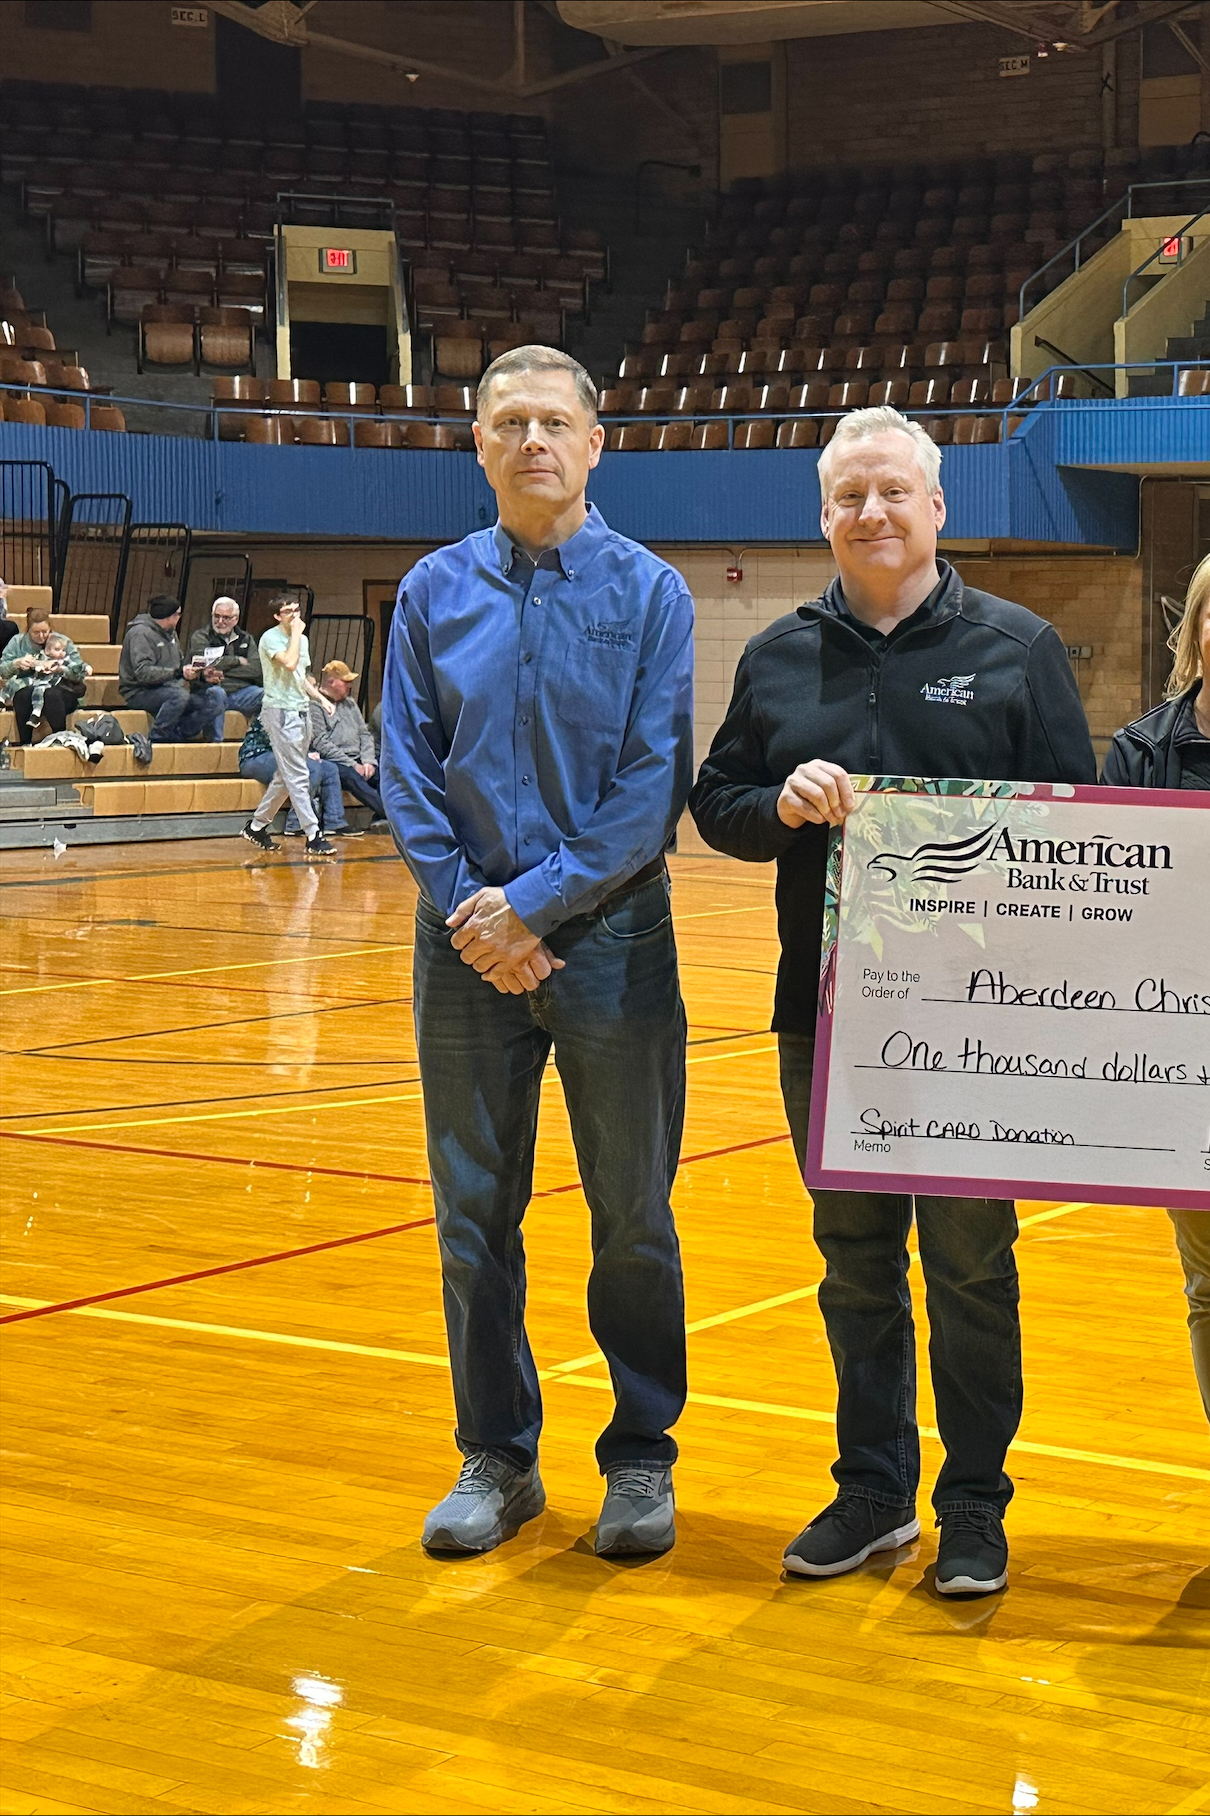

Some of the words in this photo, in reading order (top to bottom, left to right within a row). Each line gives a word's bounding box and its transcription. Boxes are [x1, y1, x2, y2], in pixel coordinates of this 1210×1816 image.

[1006, 868, 1066, 891] Bank
[1068, 873, 1089, 892] &
[1089, 871, 1150, 895] Trust
[909, 898, 976, 914] INSPIRE
[996, 902, 1061, 918] CREATE
[1081, 906, 1133, 922] GROW
[863, 968, 884, 984] Pay
[887, 970, 899, 982] to
[902, 970, 920, 983] the
[861, 985, 895, 999] Order
[897, 987, 910, 1000] of
[966, 969, 1116, 1010] Aberdeen
[881, 1030, 947, 1070] One
[957, 1037, 1088, 1079] thousand
[1102, 1051, 1188, 1083] dollars
[860, 1107, 920, 1140] Spirit
[989, 1119, 1075, 1146] Donation
[854, 1139, 891, 1153] Memo
